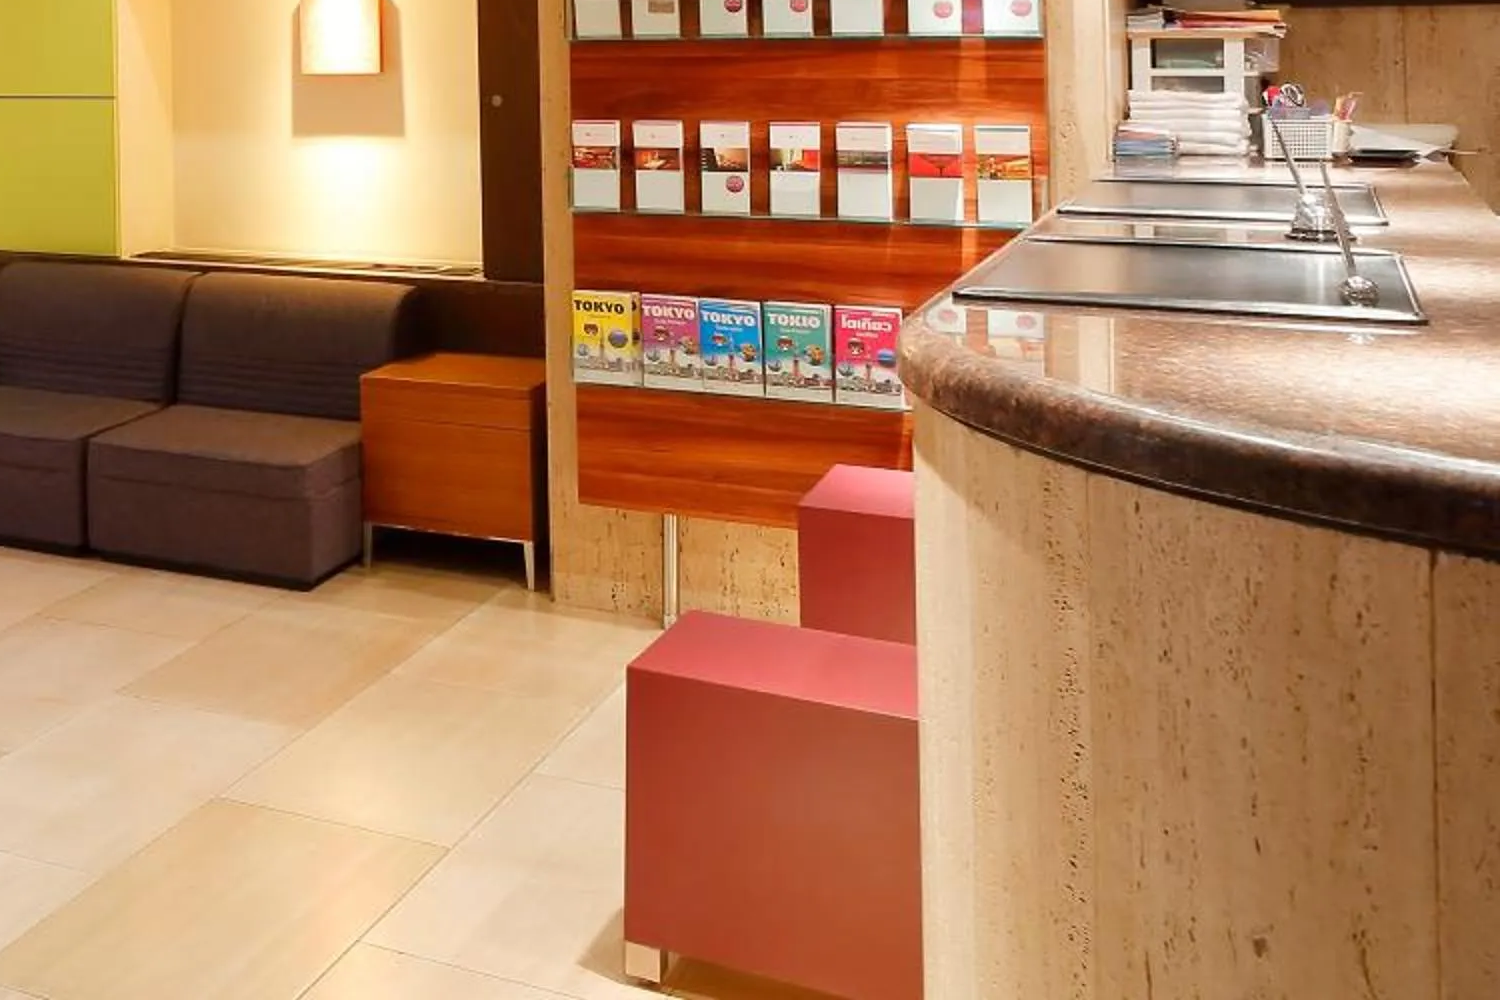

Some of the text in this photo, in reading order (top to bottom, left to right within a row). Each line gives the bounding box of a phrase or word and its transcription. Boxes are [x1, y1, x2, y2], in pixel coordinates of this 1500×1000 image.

[573, 299, 625, 315] TOKYO
[642, 305, 695, 320] TOKYO
[701, 310, 756, 327] TOKYO
[767, 312, 821, 329] TOKIO
